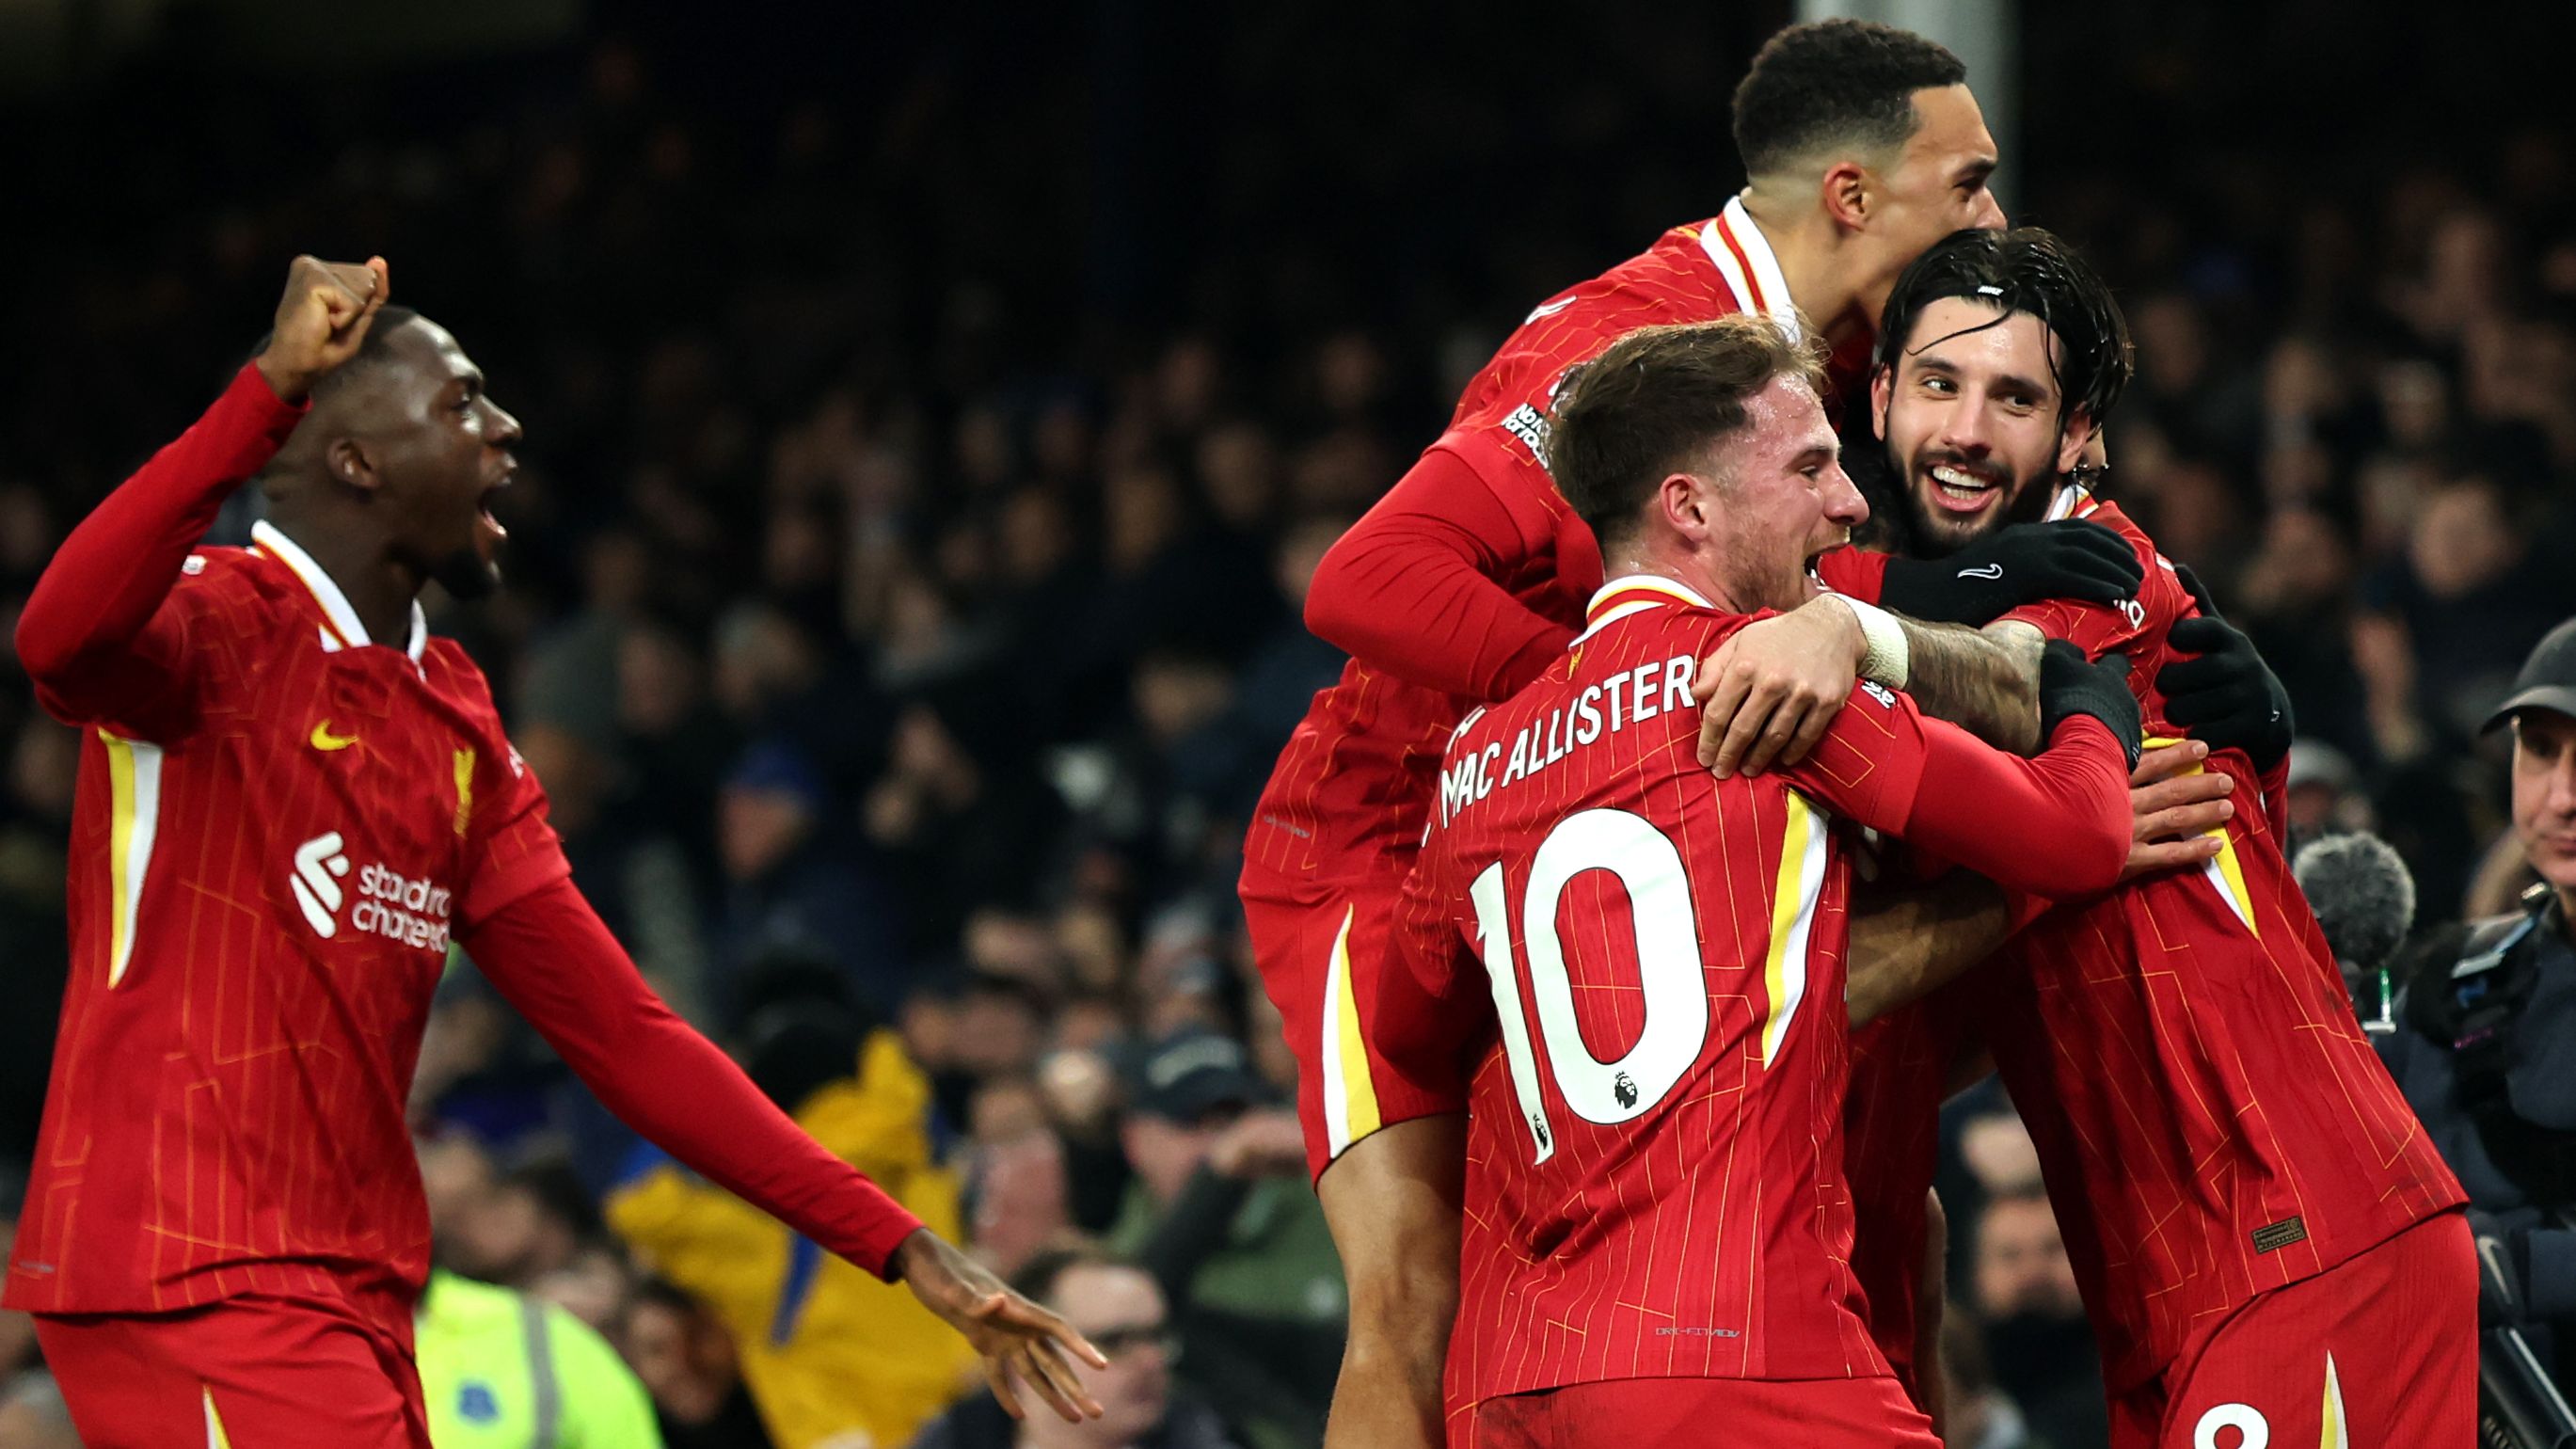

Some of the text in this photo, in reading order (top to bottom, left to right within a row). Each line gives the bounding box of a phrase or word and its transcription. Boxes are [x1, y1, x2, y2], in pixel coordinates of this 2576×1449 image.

[1440, 655, 1697, 829] MAC ALLISTER
[1469, 806, 1709, 1166] 10
